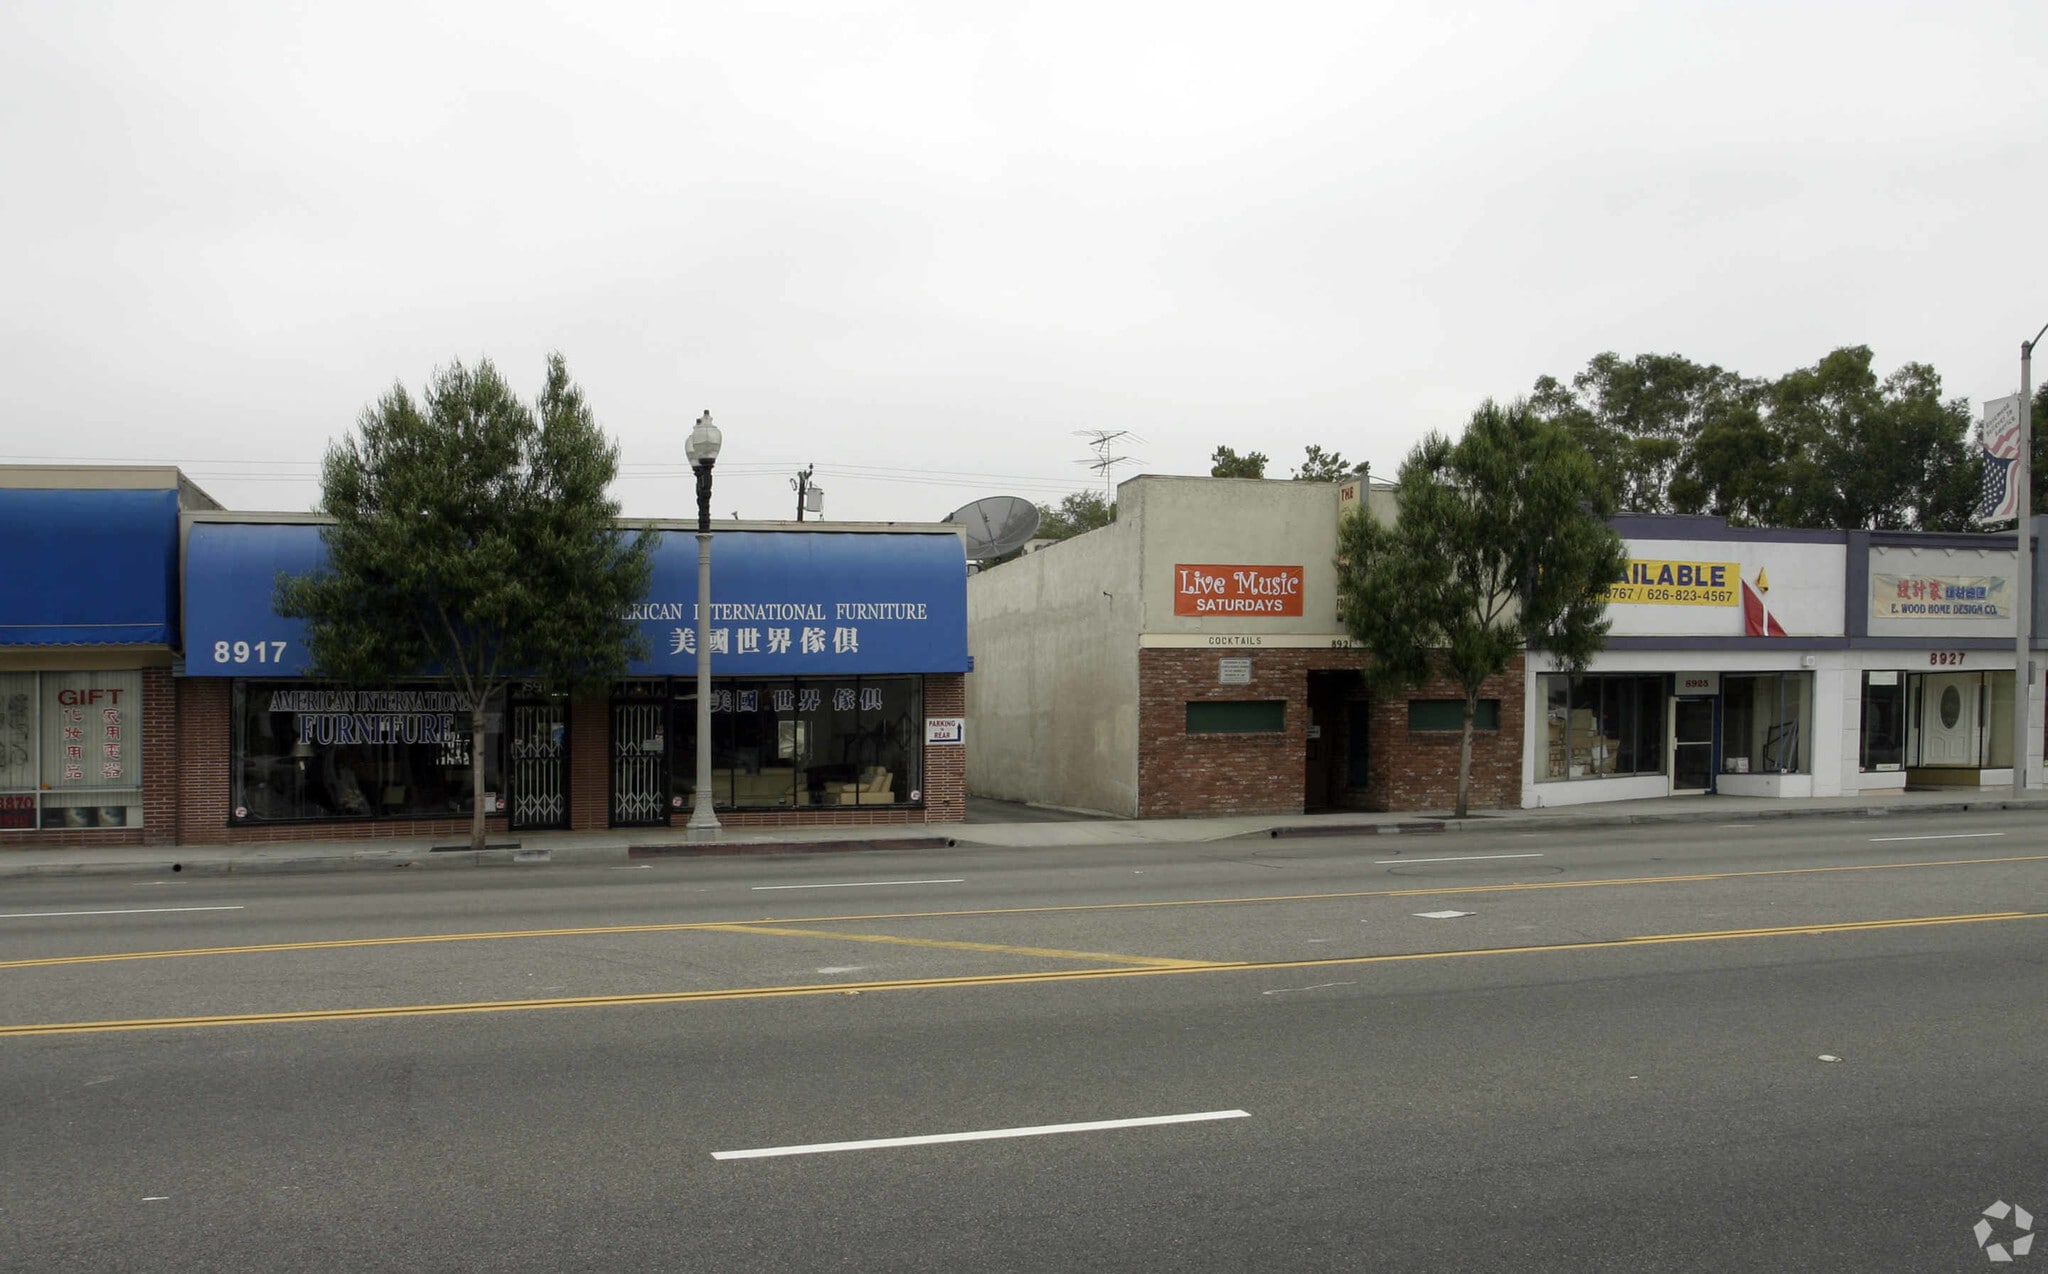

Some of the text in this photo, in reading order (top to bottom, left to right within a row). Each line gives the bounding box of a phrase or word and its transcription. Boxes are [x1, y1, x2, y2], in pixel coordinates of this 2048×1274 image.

[1341, 487, 1353, 501] THE
[1616, 563, 1726, 587] AILABLE
[1180, 570, 1299, 596] Live Music
[1647, 588, 1733, 602] 626-823-4567
[694, 603, 826, 620] ITERNATIONAL
[836, 603, 928, 620] FURNITURE
[1196, 598, 1283, 612] SATURDAYS
[1901, 603, 1926, 615] WOOD
[1928, 603, 1951, 615] HOME
[1953, 603, 1983, 615] DESIGN
[1208, 636, 1262, 645] COCKTAILS
[1331, 639, 1352, 649] 8921
[214, 640, 287, 663] 8917
[1930, 652, 1966, 665] 8927
[57, 689, 124, 706] GIFT
[268, 691, 475, 712] AMERICAN INTERNATIONA
[298, 713, 455, 745] FURNITURE
